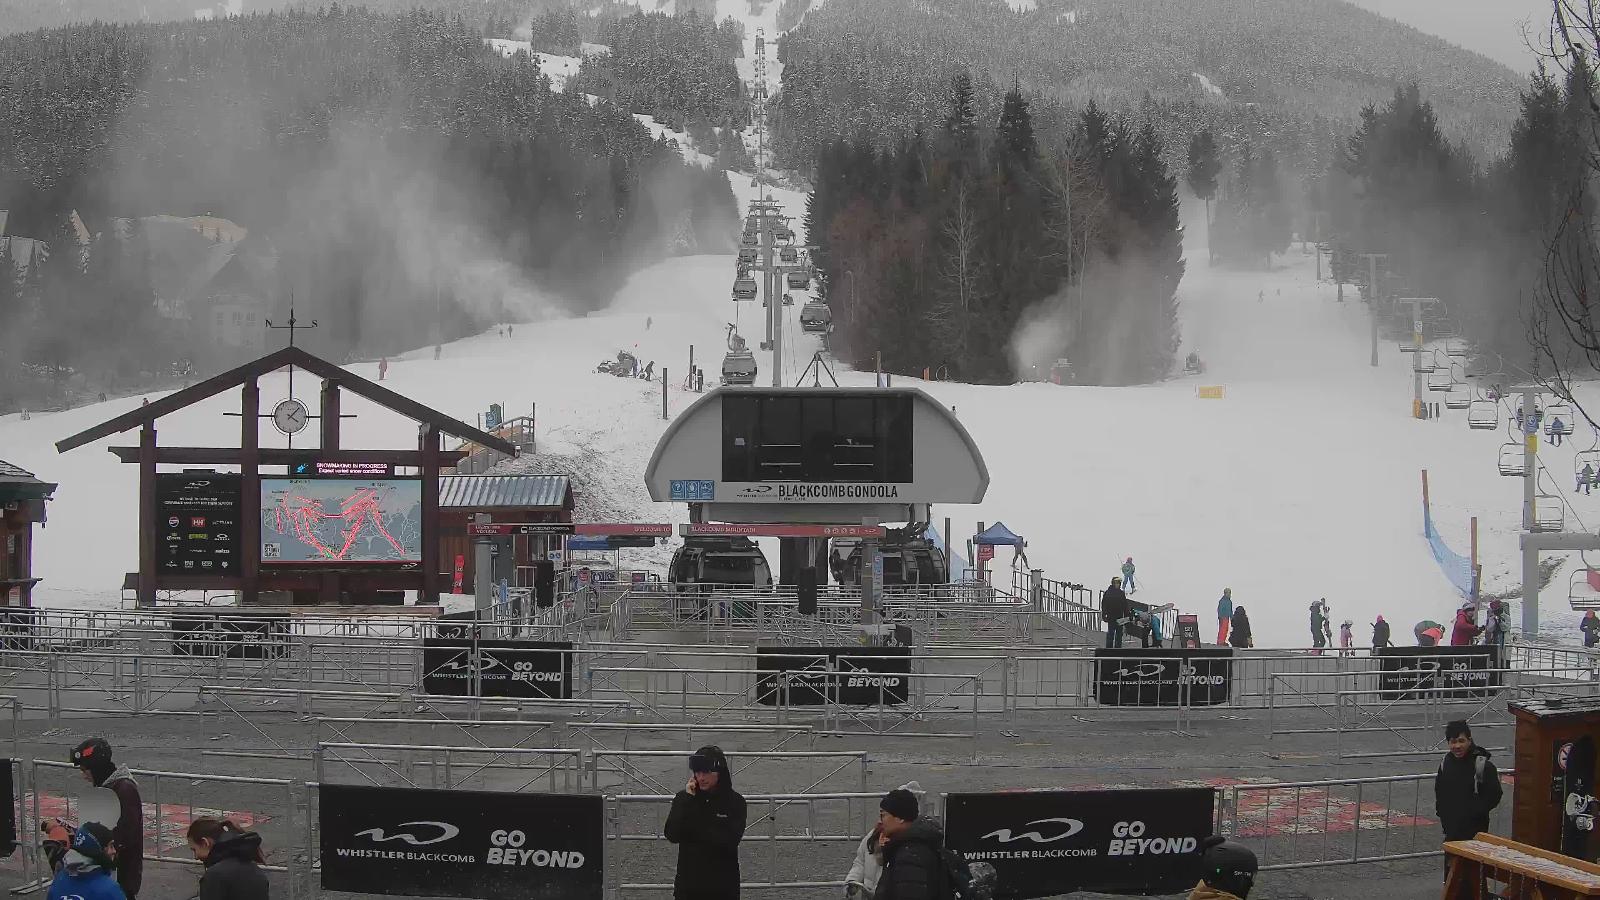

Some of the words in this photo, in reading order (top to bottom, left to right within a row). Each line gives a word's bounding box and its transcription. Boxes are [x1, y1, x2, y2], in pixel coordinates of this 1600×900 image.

[265, 319, 272, 327] N
[312, 319, 318, 327] S
[779, 485, 845, 498] BLACKCOMB
[847, 485, 898, 498] GONDOLA
[513, 661, 533, 671] GO
[1453, 662, 1468, 671] GO
[511, 671, 562, 682] BEYOND
[847, 677, 900, 687] BEYOND
[1112, 820, 1146, 838] GO
[490, 829, 526, 848] GO
[1107, 837, 1197, 856] BEYOND
[336, 848, 405, 860] WHISTLER
[407, 852, 476, 863] BLACKCOMB
[486, 847, 585, 869] BEYOND
[963, 850, 1030, 860] WHISTLER
[1031, 849, 1097, 858] BLACKCOMB
